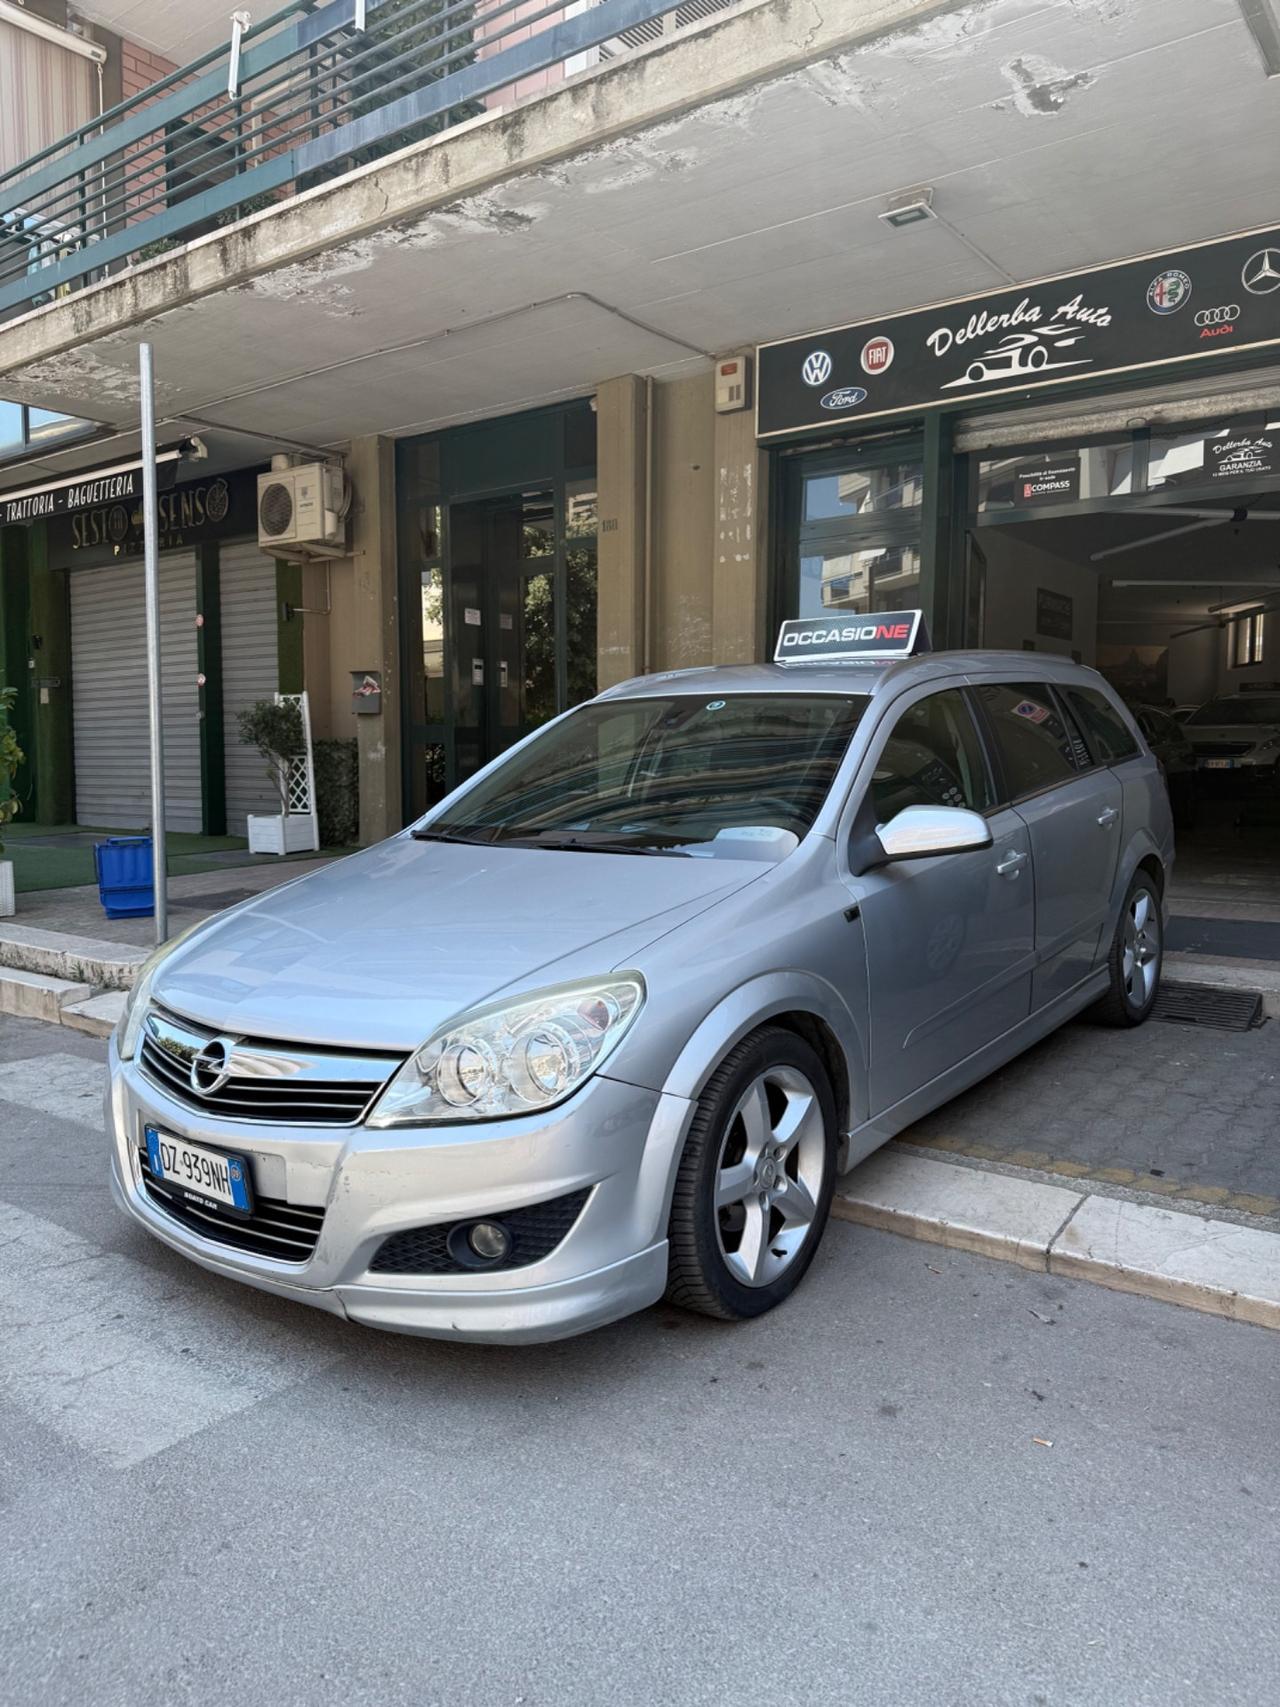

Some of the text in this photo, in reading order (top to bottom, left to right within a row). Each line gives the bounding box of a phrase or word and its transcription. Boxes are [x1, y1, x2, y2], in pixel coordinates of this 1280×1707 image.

[926, 294, 1112, 357] Dellerba Auto
[1200, 324, 1233, 338] Audi
[868, 346, 887, 366] FIAT
[829, 390, 858, 407] Ford
[1219, 460, 1262, 471] GARANZIA
[1031, 480, 1070, 492] COMPASS
[6, 493, 54, 522] TRATTORIA
[67, 474, 134, 508] BAGUETTERIA
[783, 624, 910, 647] OCCASIONE
[160, 1142, 180, 1175] DZ
[182, 1151, 231, 1195] 939NH
